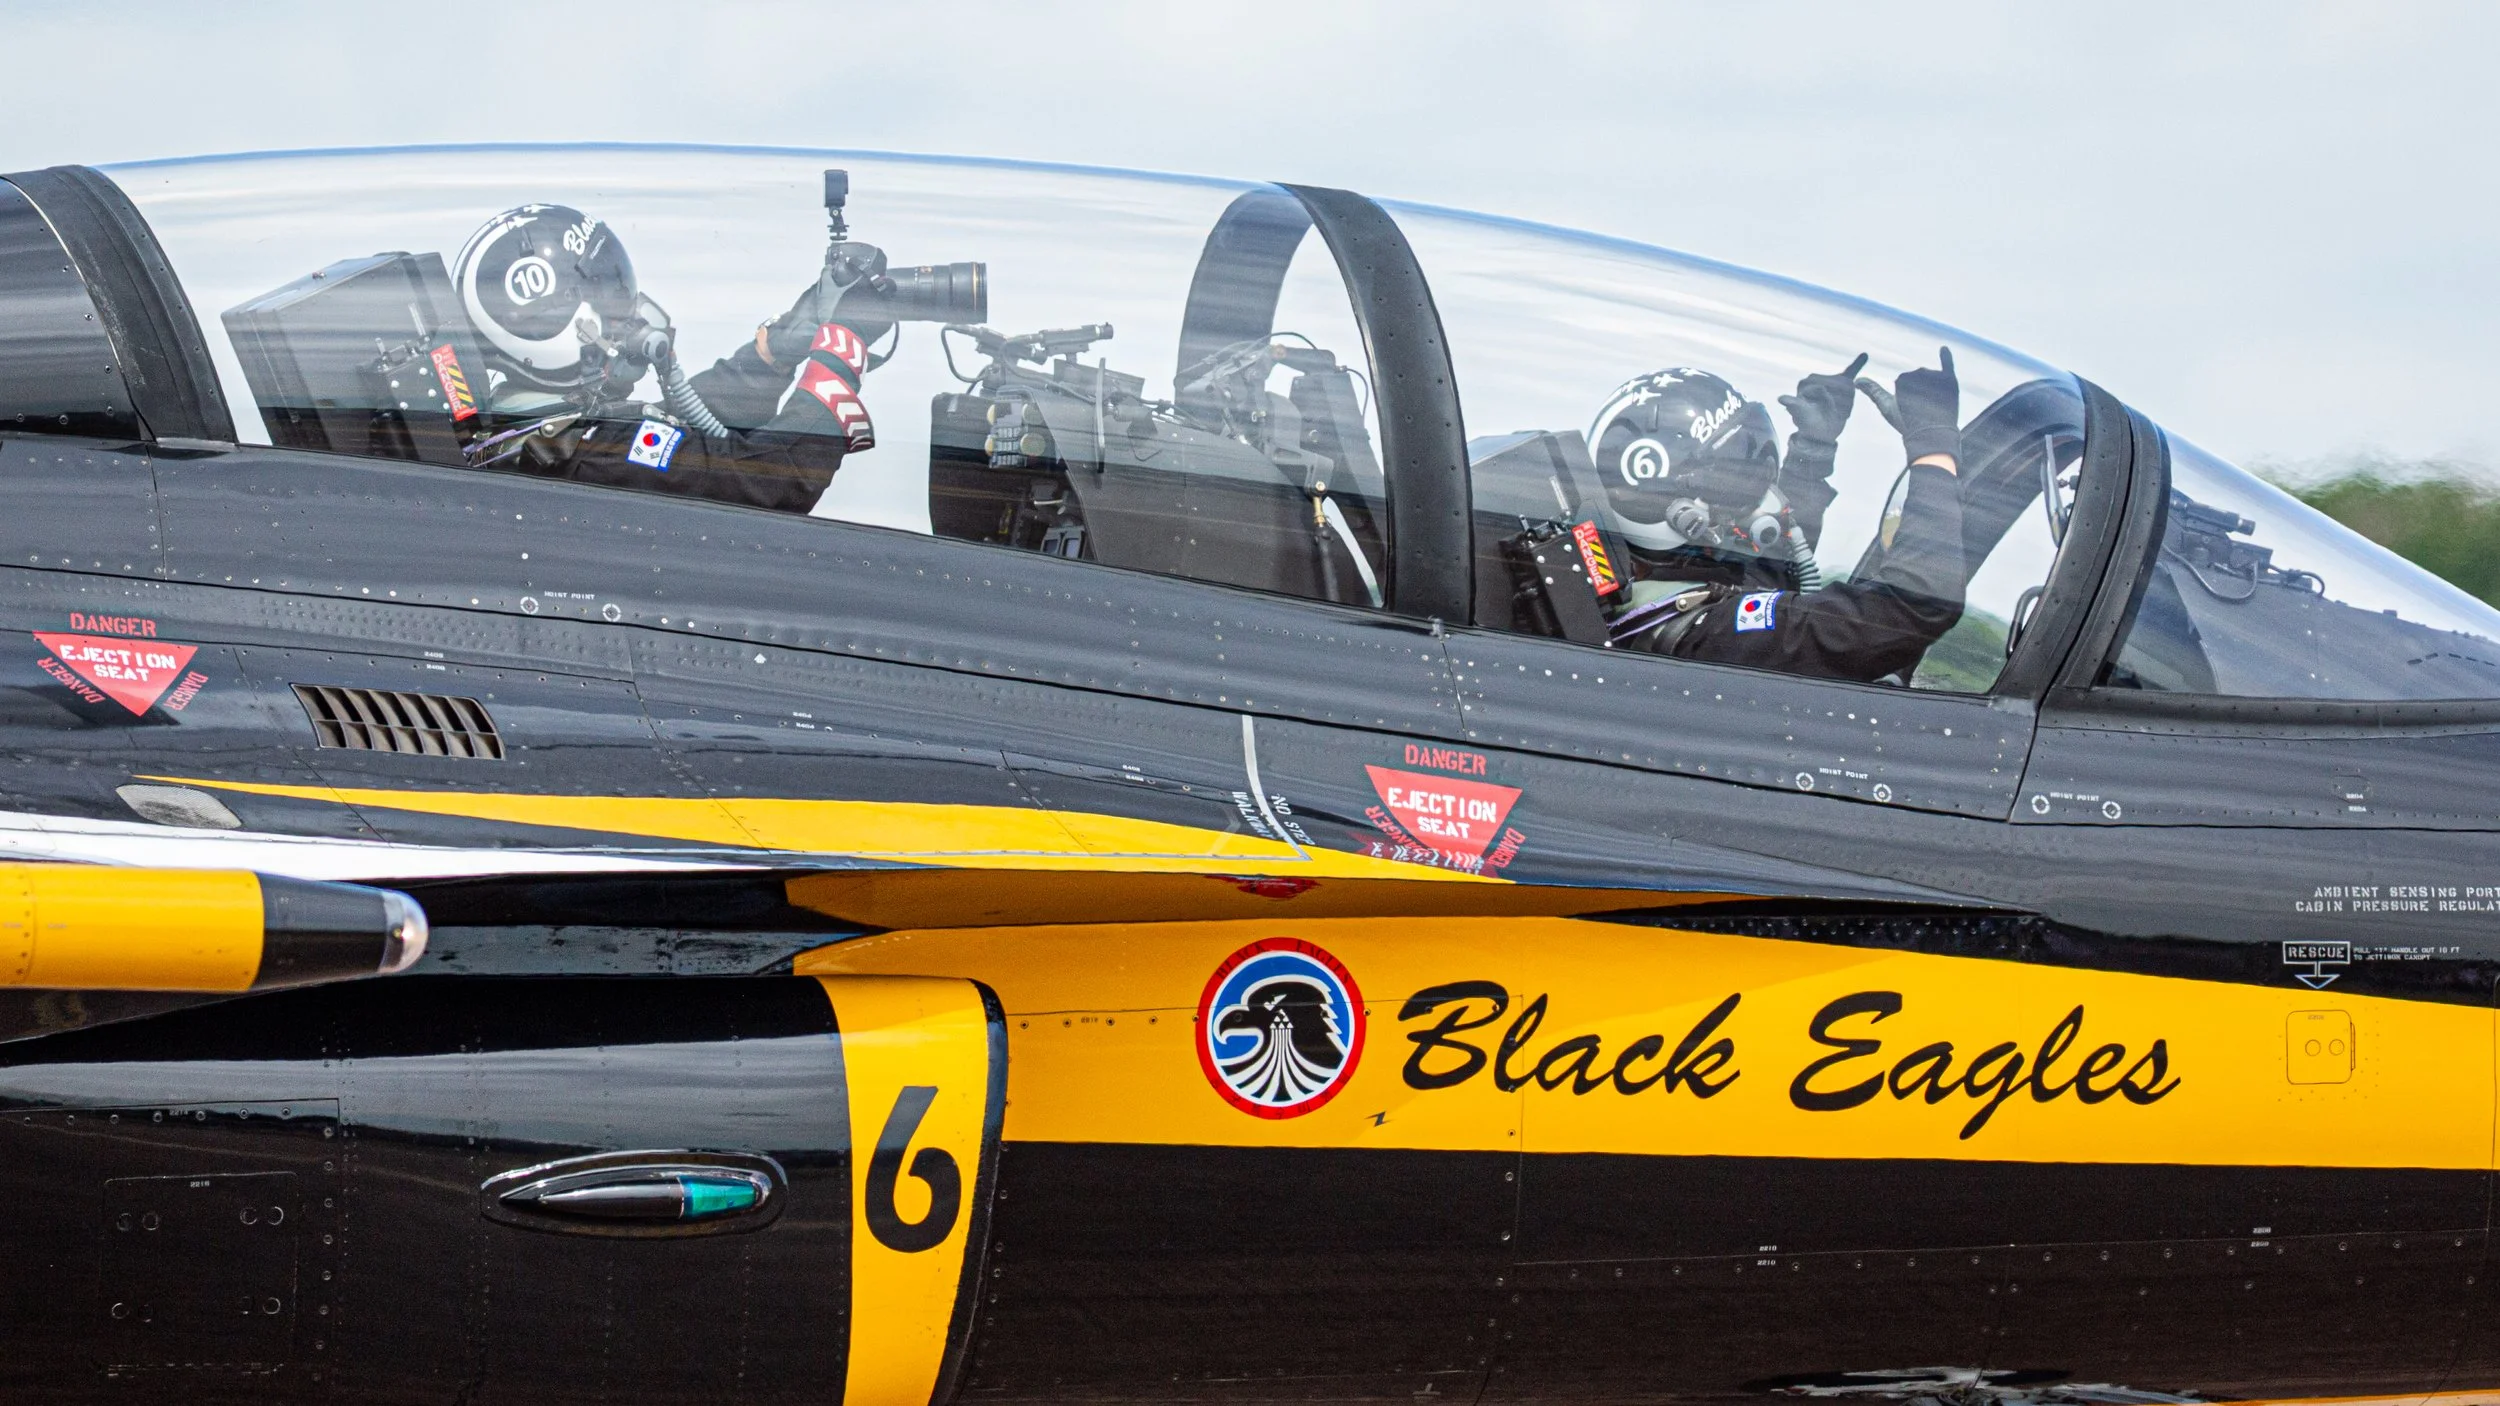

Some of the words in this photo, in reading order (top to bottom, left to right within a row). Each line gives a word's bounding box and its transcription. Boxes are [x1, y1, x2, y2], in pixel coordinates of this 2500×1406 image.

[514, 265, 546, 298] 10
[432, 353, 462, 411] DANGER
[1690, 389, 1741, 444] Black
[1633, 448, 1656, 478] 6
[1574, 529, 1603, 585] DANGER
[70, 612, 157, 637] DANGER
[59, 644, 177, 669] EJECTION
[37, 657, 106, 704] DANGER
[93, 664, 149, 682] SEAT
[163, 671, 208, 711] DANGER
[1404, 743, 1487, 776] DANGER
[1845, 770, 1869, 779] POINT
[1270, 794, 1293, 815] NO
[1387, 786, 1497, 823] EJECTION
[2076, 794, 2099, 802] POINT
[1416, 816, 1471, 839] SEAT
[1485, 827, 1527, 869] DANGER
[2295, 901, 2343, 912] CABIN
[2353, 901, 2429, 912] PRESSURE
[2314, 886, 2379, 898] AMBIENT
[2389, 886, 2457, 898] SENSING
[2288, 947, 2345, 958] RESCUE
[2353, 946, 2370, 954] PULL
[1397, 980, 1742, 1100] Black
[1789, 991, 2181, 1141] Eagles
[865, 1086, 962, 1253] 6
